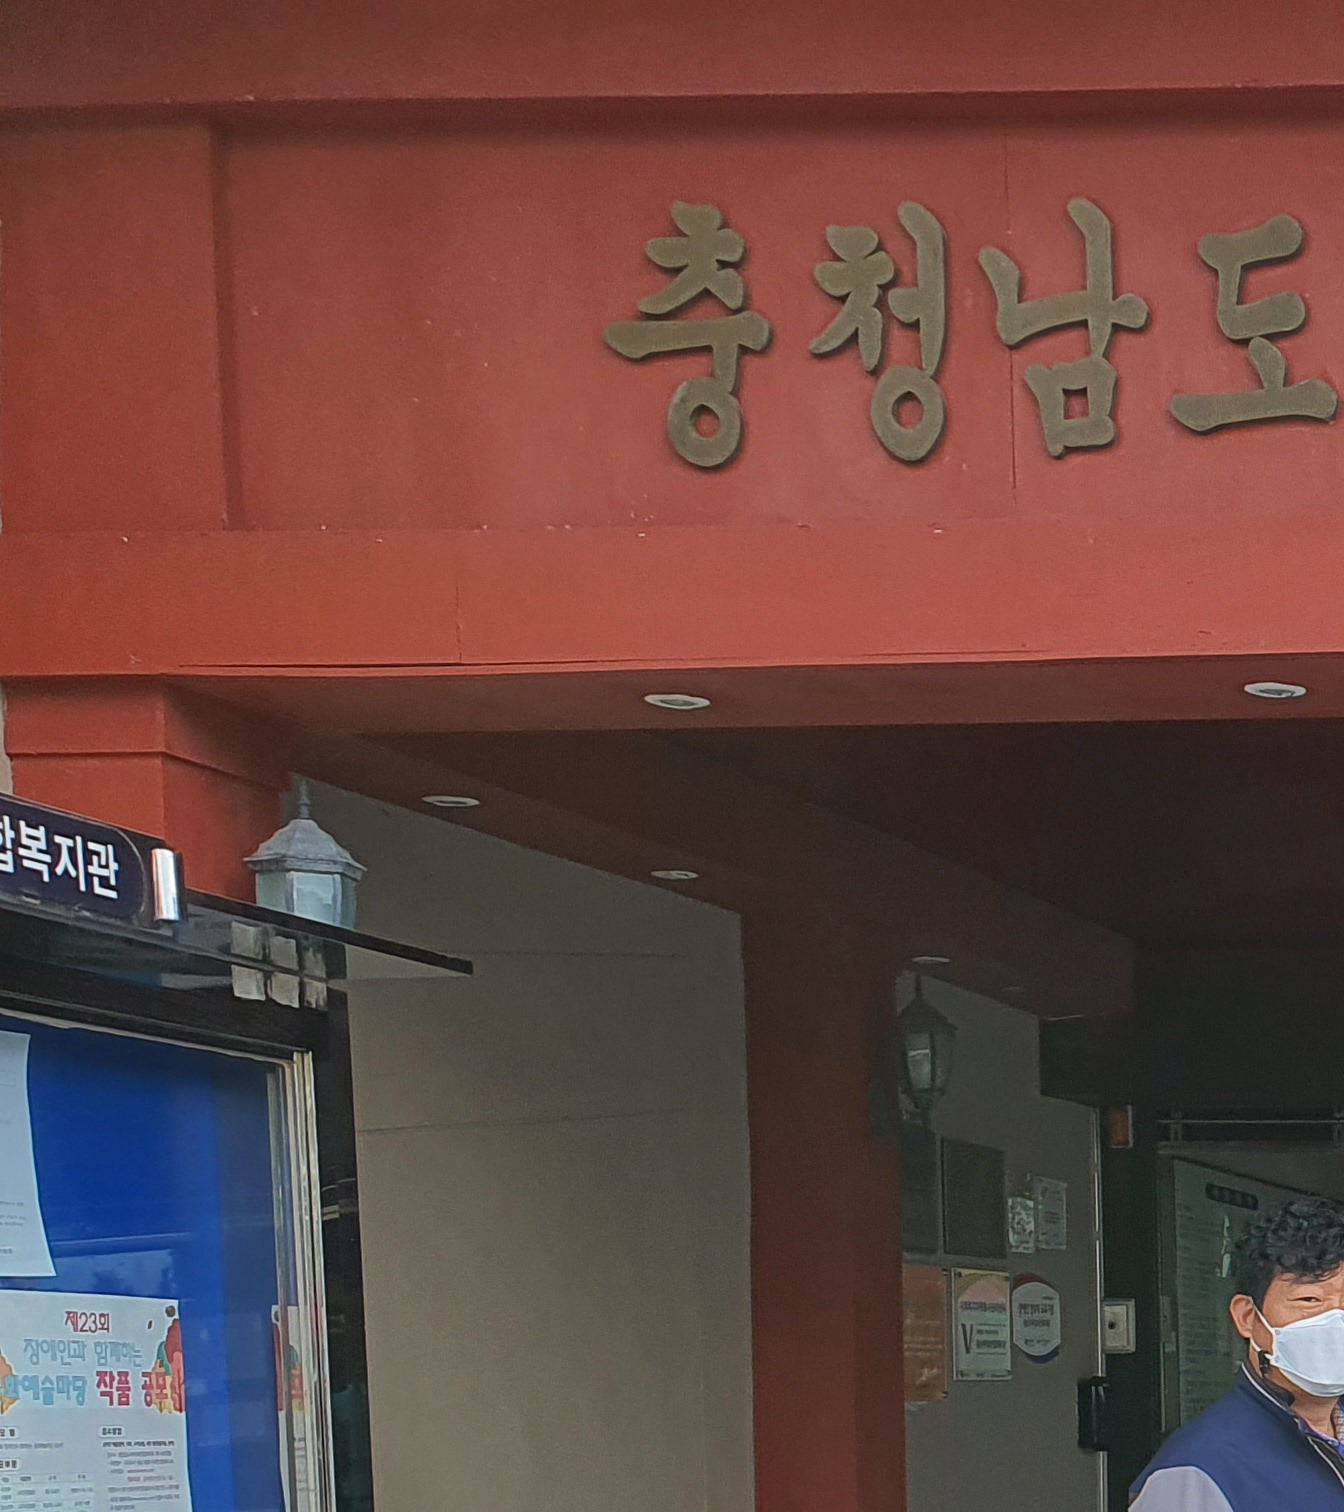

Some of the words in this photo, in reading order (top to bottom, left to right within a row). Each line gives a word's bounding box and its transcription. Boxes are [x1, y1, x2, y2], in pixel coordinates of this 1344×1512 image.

[65, 1311, 110, 1334] 제23회
[23, 1338, 87, 1366] 장애인과
[93, 1341, 143, 1367] 함께하는
[95, 1370, 132, 1406] 작품
[141, 1371, 169, 1407] 공모
